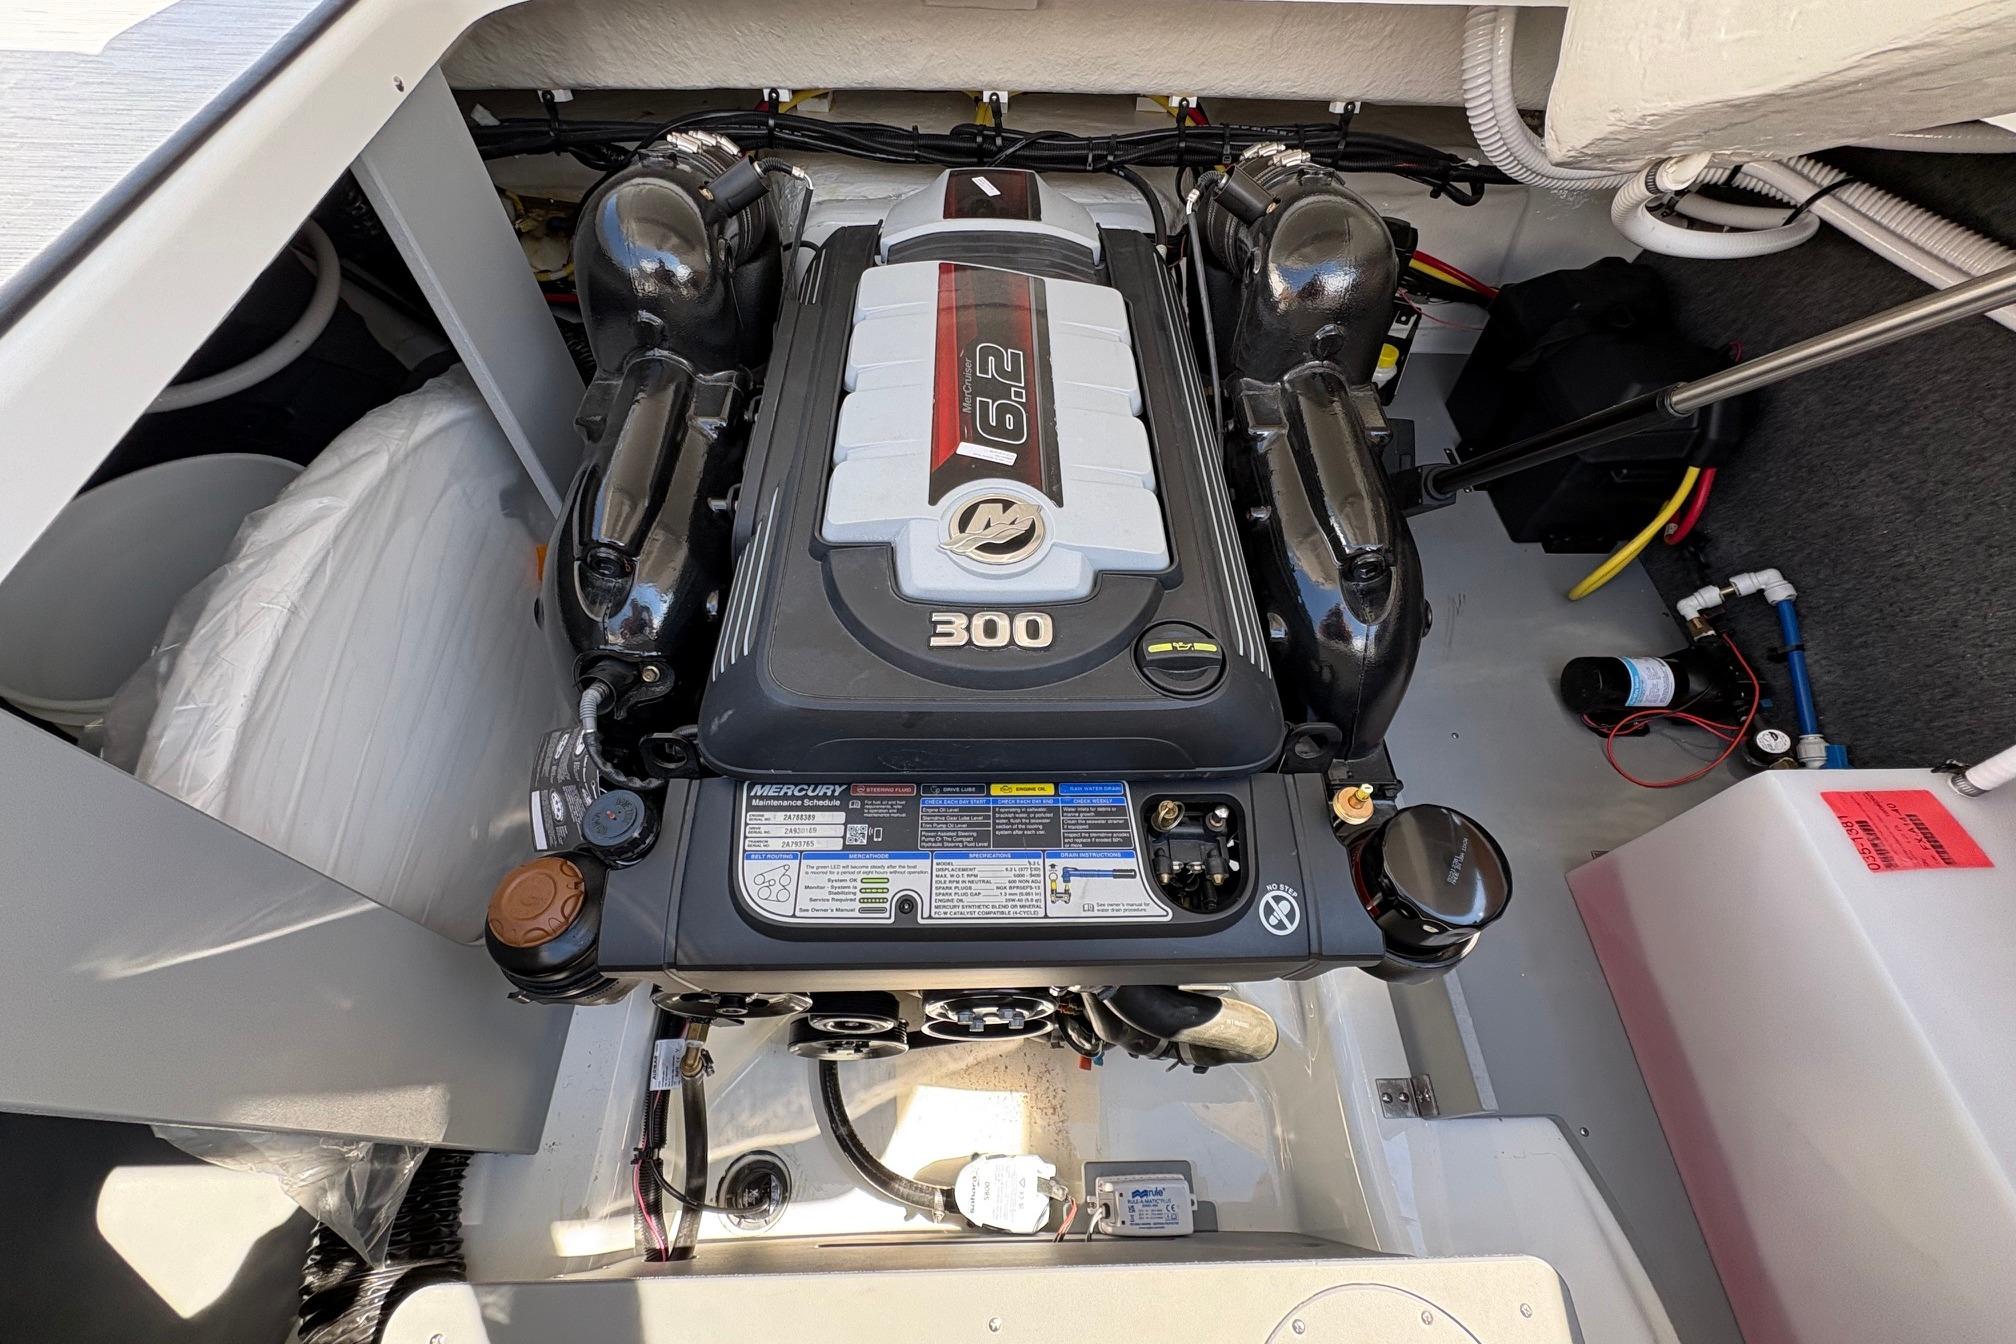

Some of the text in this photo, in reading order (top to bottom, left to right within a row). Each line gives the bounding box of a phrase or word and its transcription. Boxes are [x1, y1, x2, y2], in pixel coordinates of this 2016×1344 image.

[962, 358, 973, 414] MerCruiser
[976, 343, 1028, 444] 6.2
[930, 611, 1054, 648] 300
[750, 784, 848, 796] MERCURY
[1837, 815, 1880, 870] 035-1381
[1279, 884, 1298, 897] STEP
[1148, 1187, 1164, 1197] rule
